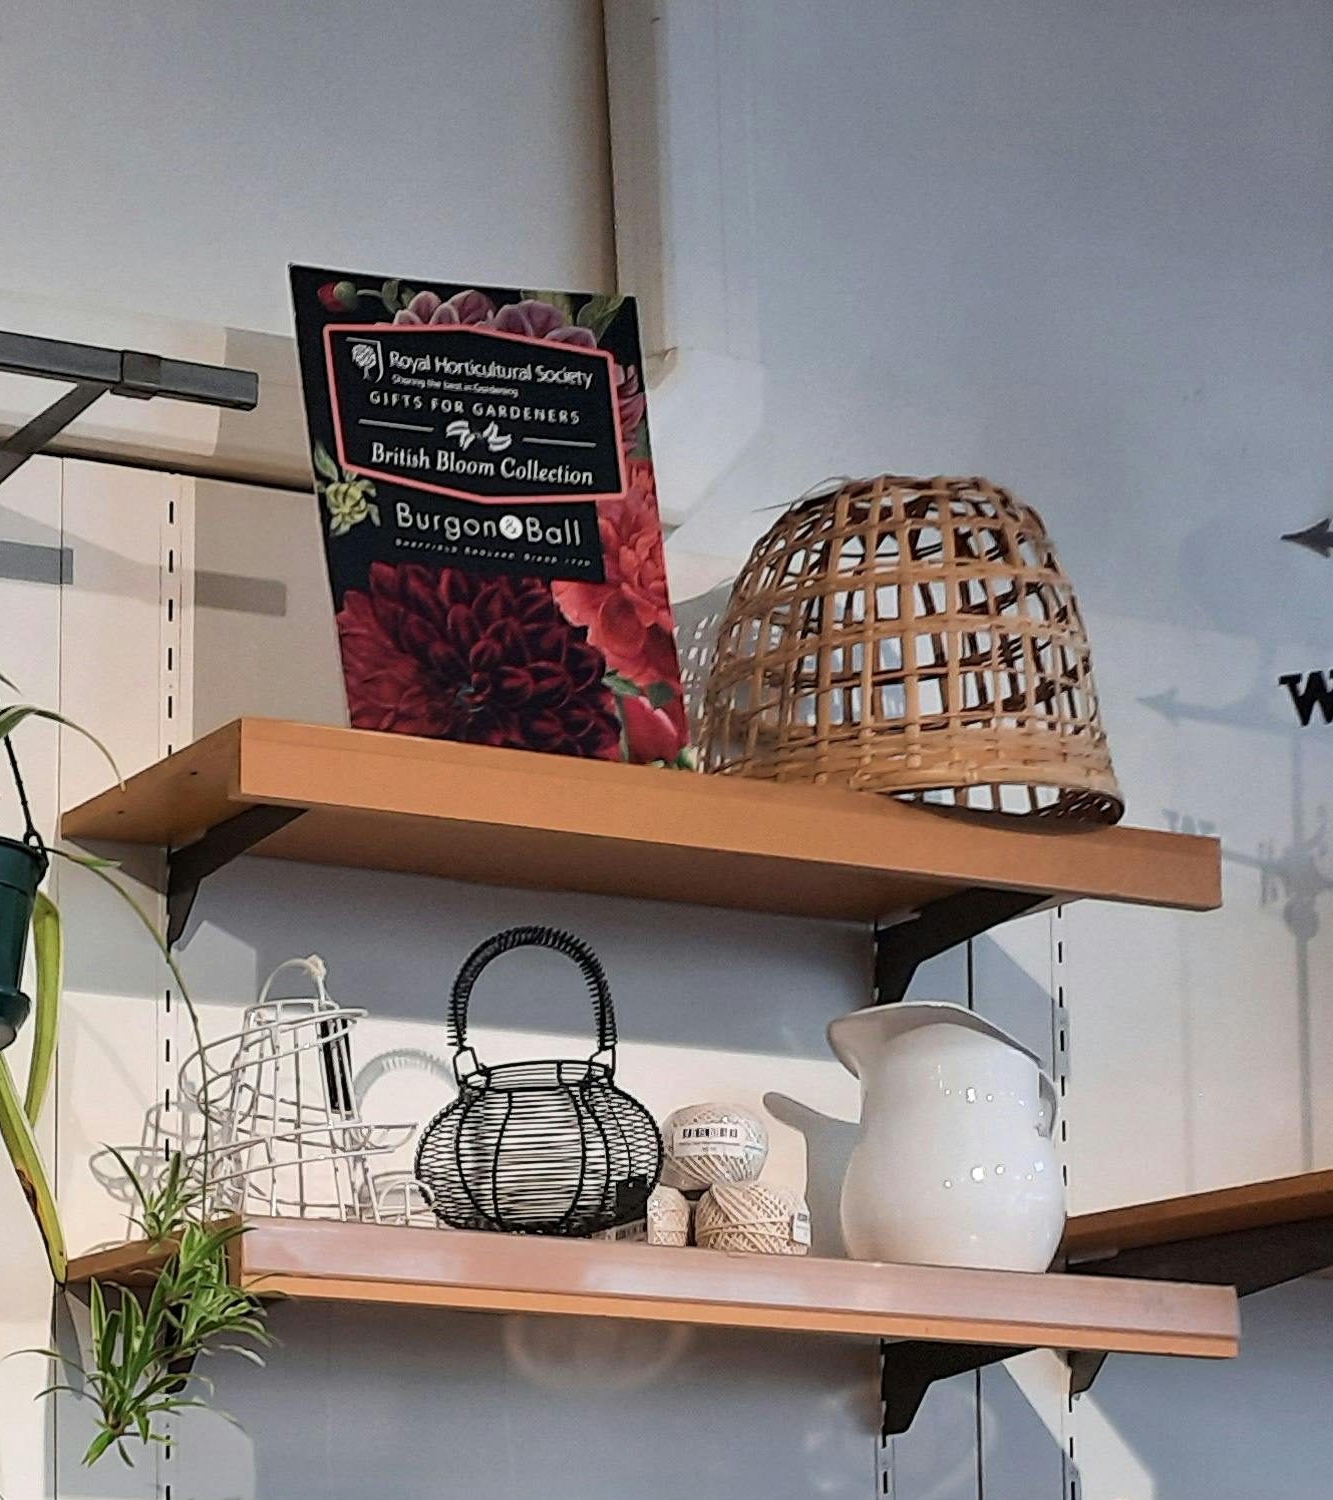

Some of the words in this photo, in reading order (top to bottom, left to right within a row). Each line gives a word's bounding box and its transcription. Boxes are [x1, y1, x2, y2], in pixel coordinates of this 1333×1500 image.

[389, 351, 430, 374] Royal
[435, 356, 532, 381] Horticultural
[535, 365, 593, 389] Society
[369, 390, 423, 409] GIFTS
[431, 398, 464, 414] FOR
[472, 402, 580, 425] GARDENERS
[371, 442, 430, 469] British
[436, 450, 495, 477] Bloom
[500, 456, 593, 486] Collection
[526, 516, 581, 546] Ball
